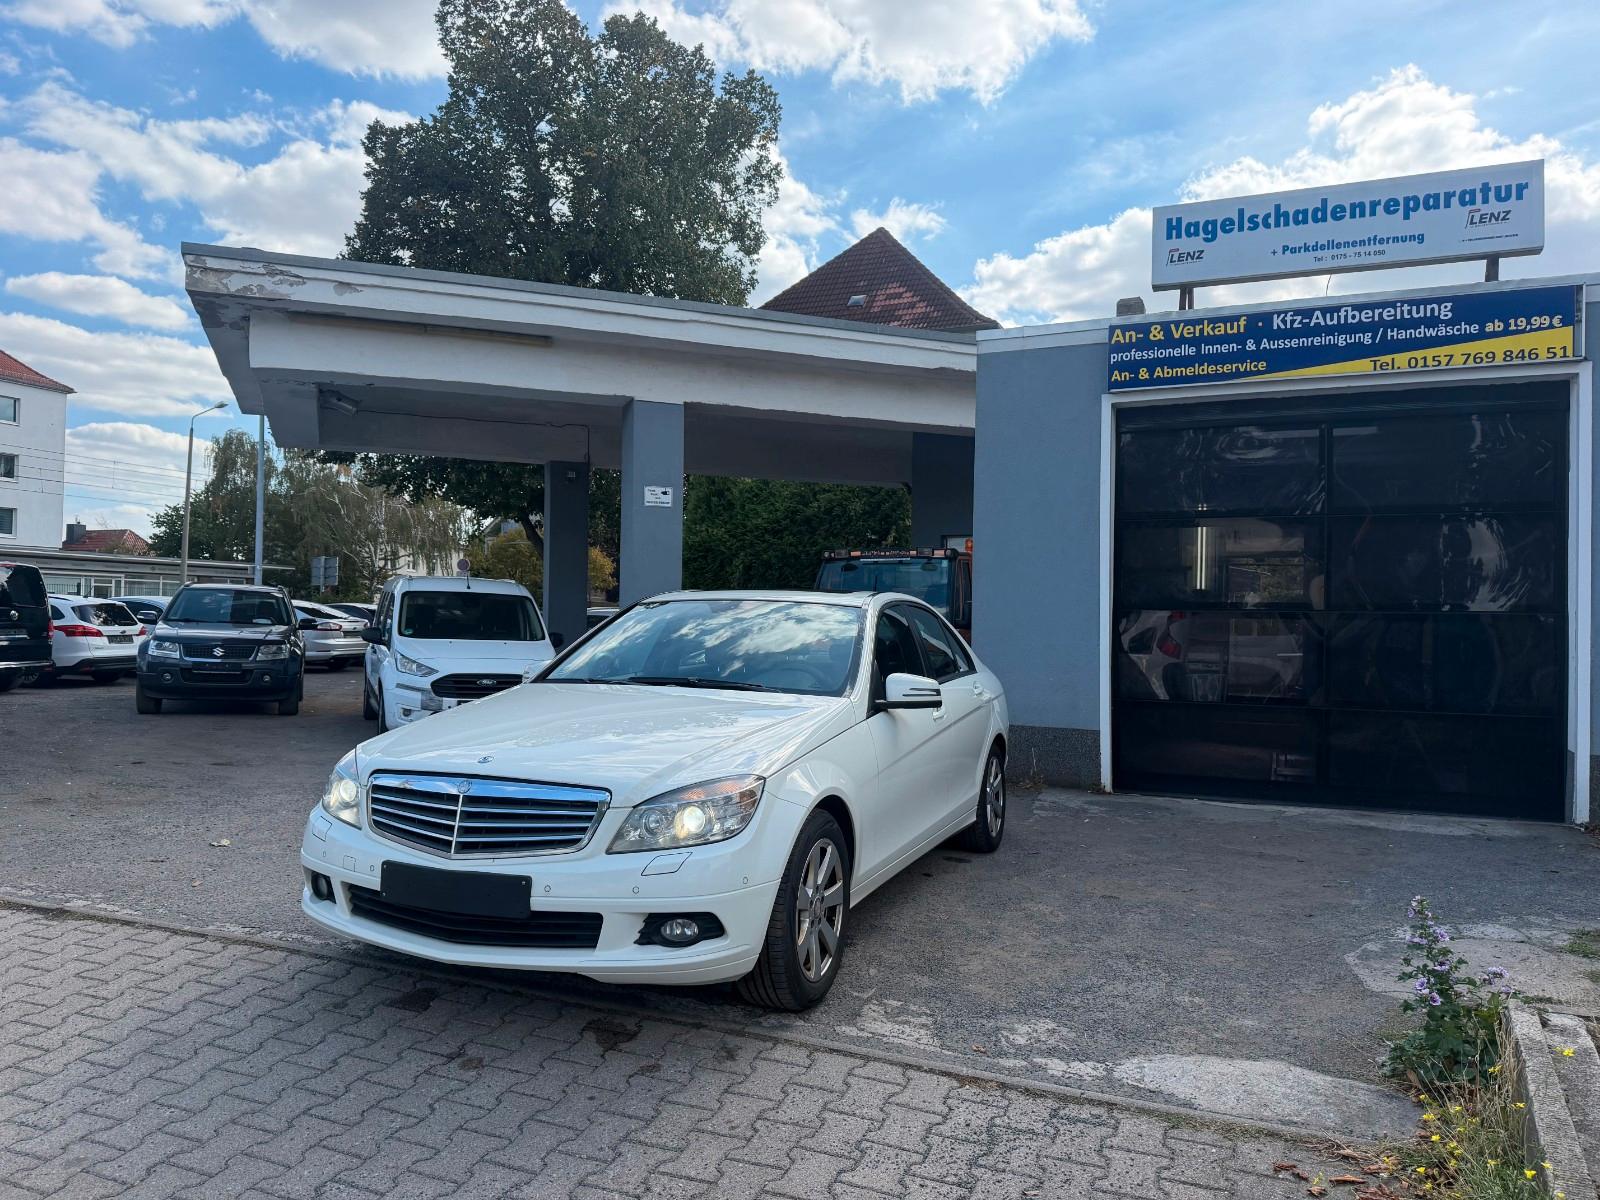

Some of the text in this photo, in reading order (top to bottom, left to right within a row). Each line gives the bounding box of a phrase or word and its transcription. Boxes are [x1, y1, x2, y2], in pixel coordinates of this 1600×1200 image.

[1166, 182, 1529, 243] Hagelschadenreparatur
[1468, 209, 1512, 226] LENZ
[1282, 233, 1425, 255] Parkdellenentfernung
[1169, 249, 1205, 264] LENZ
[1331, 253, 1347, 261] 0175
[1111, 328, 1143, 344] An-
[1149, 325, 1164, 341] &
[1170, 317, 1247, 339] Verkauf
[1273, 302, 1453, 330] Kfz-Aufbereitung
[1110, 344, 1196, 364] professionelle
[1201, 342, 1242, 355] Innen-
[1246, 339, 1257, 351] &
[1260, 331, 1372, 350] Aussenreinigung
[1376, 328, 1383, 343] /
[1387, 321, 1479, 340] Handwäsche
[1485, 318, 1503, 332] ab
[1370, 345, 1570, 372] Tel. 0157 769 846 51
[1111, 360, 1267, 382] An- & Abmeldeservice
